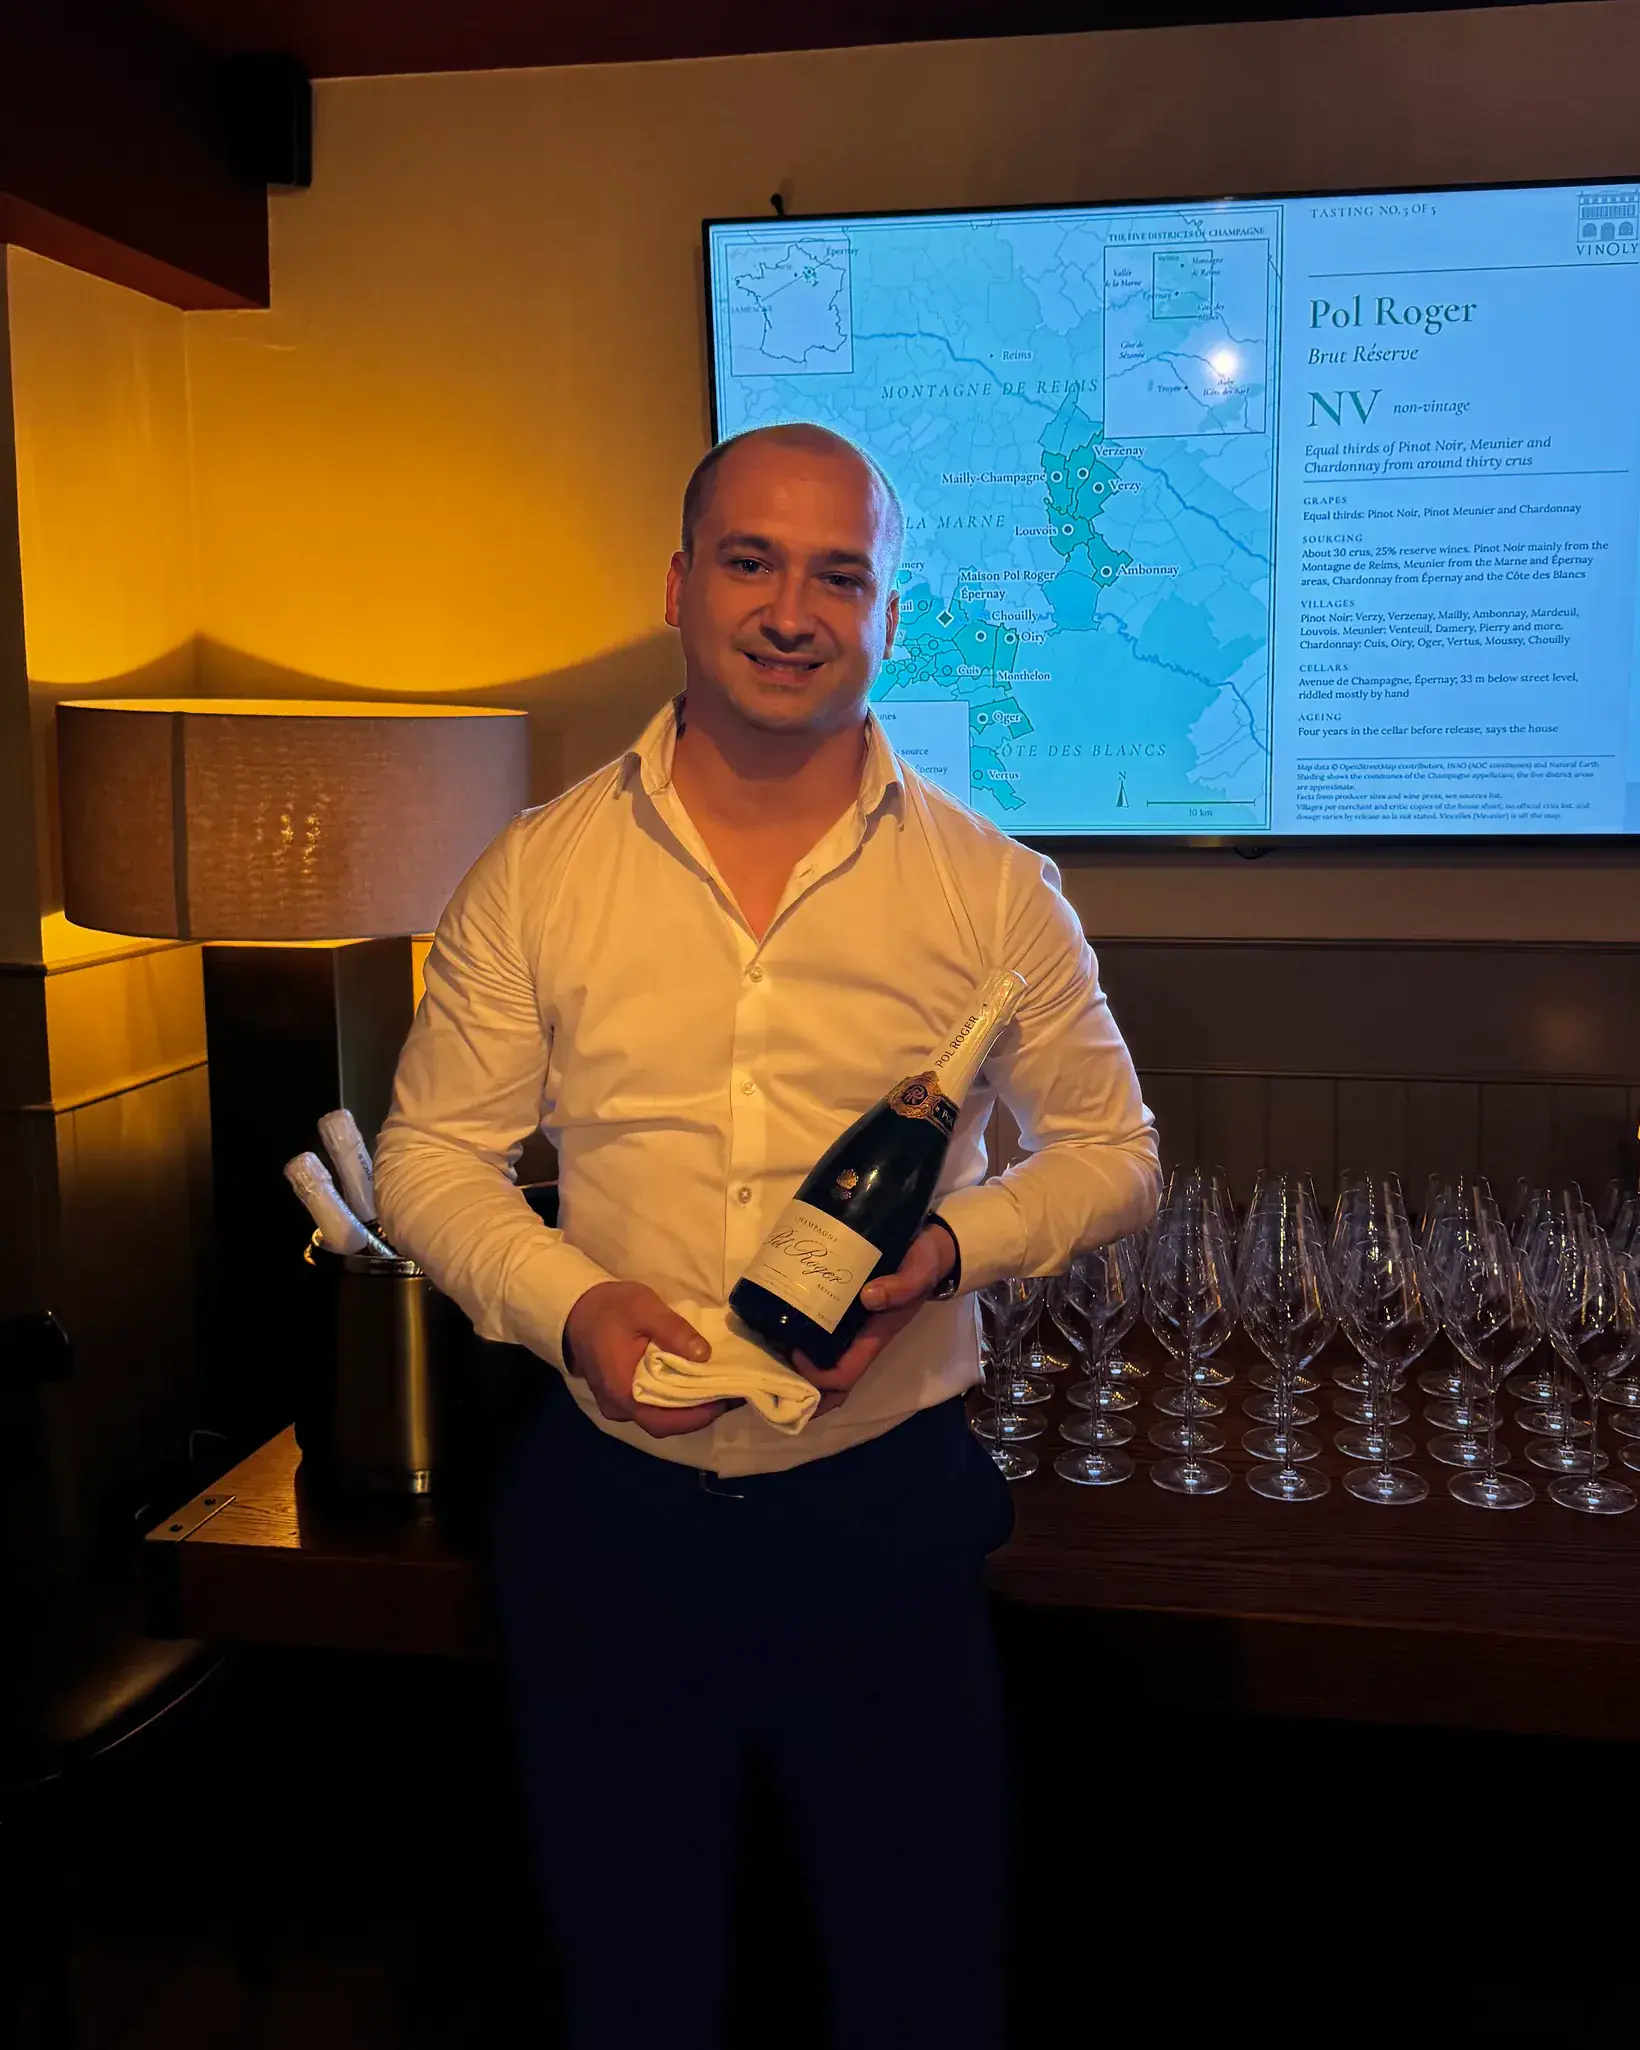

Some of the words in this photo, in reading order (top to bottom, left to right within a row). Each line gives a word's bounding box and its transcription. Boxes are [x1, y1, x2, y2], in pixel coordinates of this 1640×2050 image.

[1309, 206, 1374, 219] TASTING
[1379, 205, 1401, 216] NO.
[1411, 203, 1428, 214] OF
[1209, 227, 1265, 237] CHAMPAGNE
[1576, 242, 1639, 256] VINOLY
[1310, 294, 1362, 329] Pol
[1374, 296, 1478, 336] Roger
[1002, 348, 1033, 362] Reims
[1307, 348, 1347, 365] Brut
[1352, 342, 1419, 363] Réserve
[881, 380, 992, 400] MONTAGNE
[1002, 382, 1029, 396] DE
[1037, 379, 1099, 395] REIMS
[1307, 388, 1383, 428] NV
[1393, 399, 1471, 417] non-vintage
[1095, 443, 1145, 459] Verzenay
[1304, 443, 1341, 460] Equal
[1342, 442, 1380, 455] thirds
[1382, 440, 1397, 457] of
[1398, 441, 1431, 453] Pinot
[1435, 439, 1467, 452] Noir,
[1469, 437, 1525, 450] Meunier
[1526, 435, 1552, 448] and
[1304, 460, 1381, 475] Chardonnay
[1380, 458, 1414, 475] from
[1416, 455, 1463, 470] around
[1465, 455, 1503, 471] thirty
[1505, 456, 1533, 467] crus
[941, 471, 1046, 486] Mailly-Champagne
[1109, 479, 1142, 493] Verzy
[1303, 496, 1347, 506] GRAPES
[1303, 510, 1331, 523] Equal
[1332, 509, 1365, 521] thirds:
[1367, 509, 1395, 519] Pinot
[1423, 507, 1450, 517] Pinot
[1452, 505, 1496, 516] Meunier
[1497, 504, 1517, 515] and
[1518, 503, 1582, 517] Chardonnay
[905, 515, 927, 530] LA
[936, 513, 1005, 528] MARNE
[1015, 524, 1058, 536] Louvois
[1302, 533, 1363, 545] SOURCING
[1301, 548, 1332, 558] About
[1333, 547, 1347, 558] 30
[1375, 546, 1397, 557] 25%
[1398, 547, 1437, 556] reserve
[1439, 544, 1471, 554] wines.
[1473, 543, 1501, 553] Pinot
[1502, 542, 1526, 553] Noir
[1527, 541, 1563, 554] mainly
[1564, 541, 1590, 551] from
[1591, 540, 1609, 551] the
[900, 559, 925, 571] mery
[1118, 563, 1180, 578] Ambonnay
[1301, 561, 1352, 574] Montagne
[1352, 560, 1367, 571] de
[1403, 558, 1446, 569] Meunier
[1447, 557, 1473, 568] from
[1475, 557, 1493, 567] the
[1494, 557, 1528, 567] Marne
[1529, 555, 1549, 565] and
[1551, 553, 1594, 567] Épernay
[960, 570, 1001, 581] Maison
[1003, 569, 1022, 581] Pol
[1024, 568, 1056, 583] Roger
[1331, 574, 1393, 587] Chardonnay
[1394, 574, 1419, 586] from
[1421, 571, 1463, 585] Épernay
[1464, 571, 1484, 582] and
[1486, 571, 1504, 581] the
[1505, 570, 1531, 581] Côte
[1532, 569, 1551, 580] des
[1553, 570, 1587, 580] Blancs
[960, 587, 1006, 601] Épernay
[1300, 599, 1355, 609] VILLAGES
[992, 610, 1039, 623] Chouilly
[1301, 613, 1327, 623] Pinot
[1342, 625, 1387, 636] Meunier:
[1479, 622, 1511, 635] Pierry
[1511, 621, 1532, 632] and
[1021, 631, 1047, 645] Oiry
[1390, 638, 1415, 651] Oiry,
[1527, 634, 1571, 647] Chouilly
[958, 665, 980, 676] Cuis
[1299, 663, 1349, 673] CELLARS
[997, 670, 1051, 682] Monthelon
[1298, 678, 1335, 687] Avenue
[1335, 676, 1349, 686] de
[1459, 674, 1473, 684] 33
[1487, 673, 1519, 683] below
[1520, 674, 1550, 682] street
[1298, 689, 1333, 700] riddled
[1335, 689, 1369, 702] mostly
[1369, 689, 1384, 701] by
[1384, 688, 1410, 699] hand
[993, 712, 1021, 725] Oger
[1297, 712, 1342, 722] AGEING
[1298, 726, 1321, 736] Four
[1322, 728, 1349, 739] years
[1350, 726, 1361, 736] in
[1362, 726, 1380, 736] the
[1380, 725, 1409, 736] cellar
[1410, 725, 1443, 735] before
[1485, 726, 1508, 736] says
[1509, 724, 1526, 734] the
[1528, 723, 1559, 733] house
[901, 747, 929, 756] source
[1048, 744, 1082, 757] DES
[1092, 743, 1167, 757] BLANCS
[988, 770, 1019, 780] Vertus
[1118, 771, 1127, 779] N
[1189, 808, 1198, 817] 10
[1199, 808, 1213, 817] km
[935, 1049, 955, 1068] POL
[950, 1015, 979, 1049] ROGER
